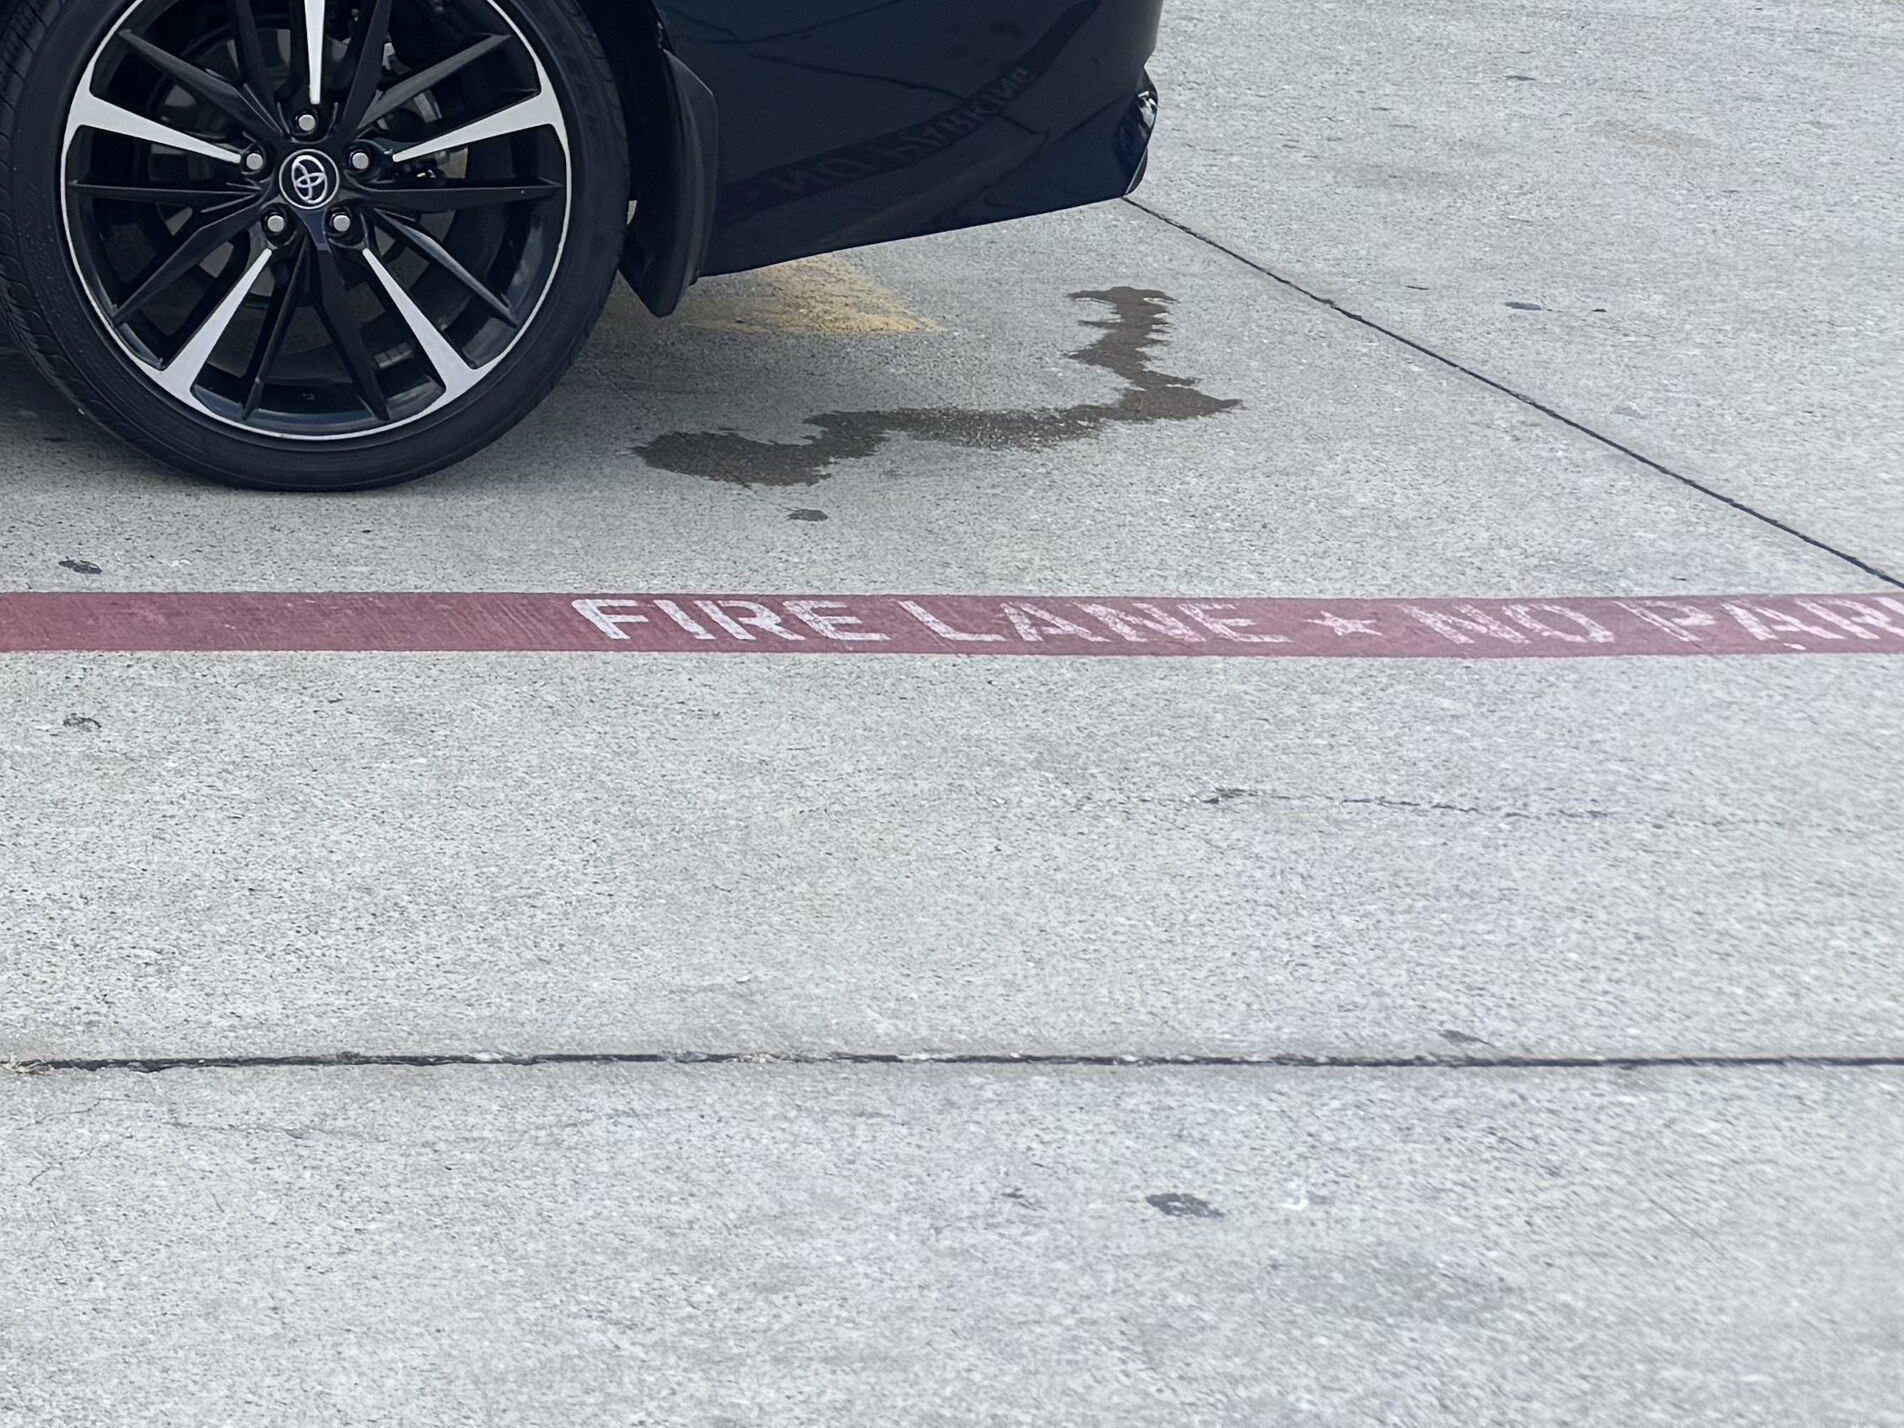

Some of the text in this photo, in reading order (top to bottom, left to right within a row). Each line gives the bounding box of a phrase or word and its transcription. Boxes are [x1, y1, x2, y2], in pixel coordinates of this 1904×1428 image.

[571, 596, 1904, 644] FIRE LANE NO PAR
